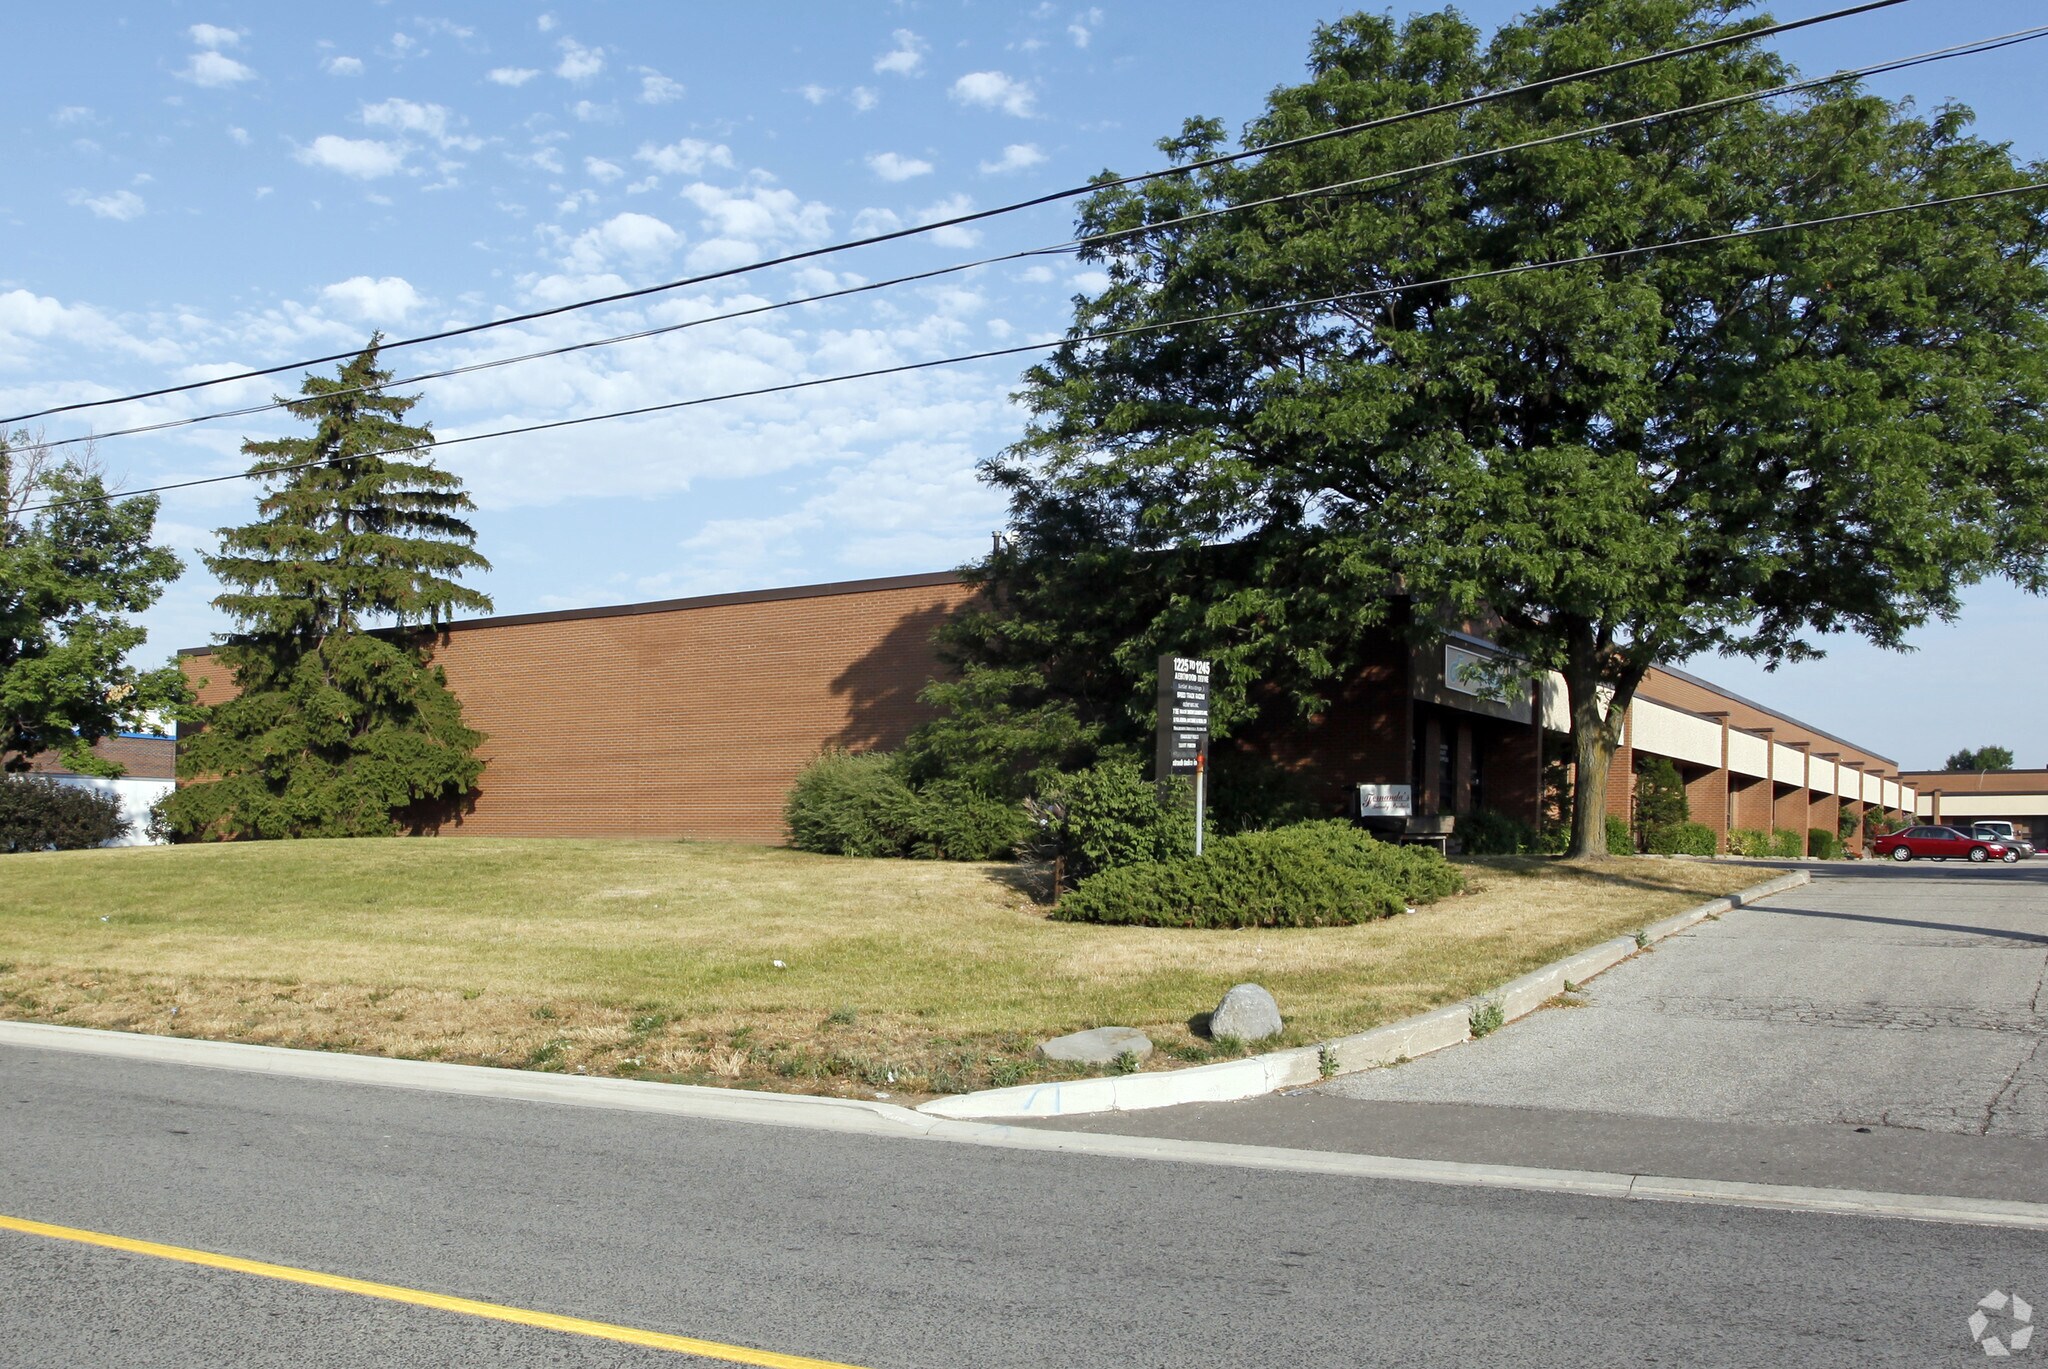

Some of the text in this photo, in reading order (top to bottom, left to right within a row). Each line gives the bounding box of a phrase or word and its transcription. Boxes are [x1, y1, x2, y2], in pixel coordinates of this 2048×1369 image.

[1174, 657, 1210, 675] 1225 TO 1245
